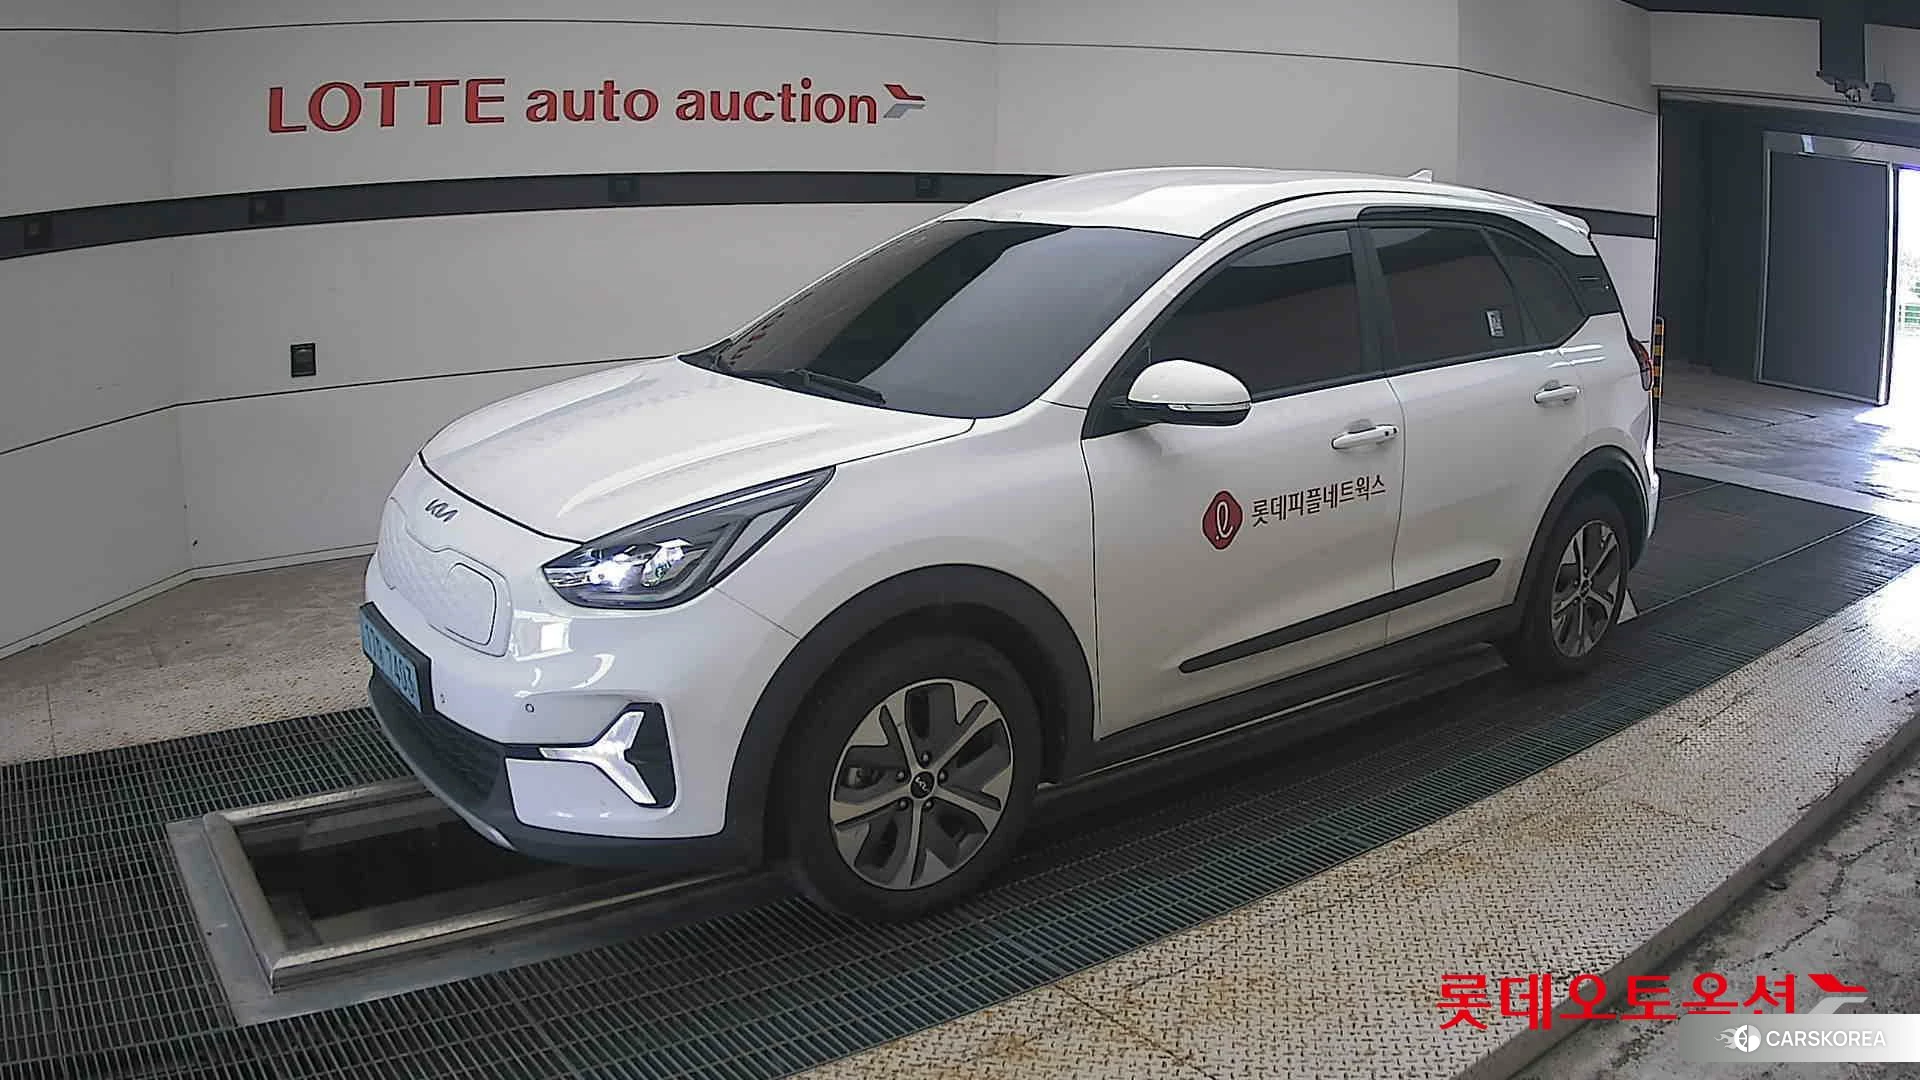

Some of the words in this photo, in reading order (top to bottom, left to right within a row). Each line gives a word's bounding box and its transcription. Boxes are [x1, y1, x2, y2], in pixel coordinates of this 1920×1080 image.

[268, 78, 505, 133] LOTTE
[526, 79, 660, 123] auto
[675, 77, 879, 125] auction
[1251, 474, 1387, 528] 롯데피플네트웍스
